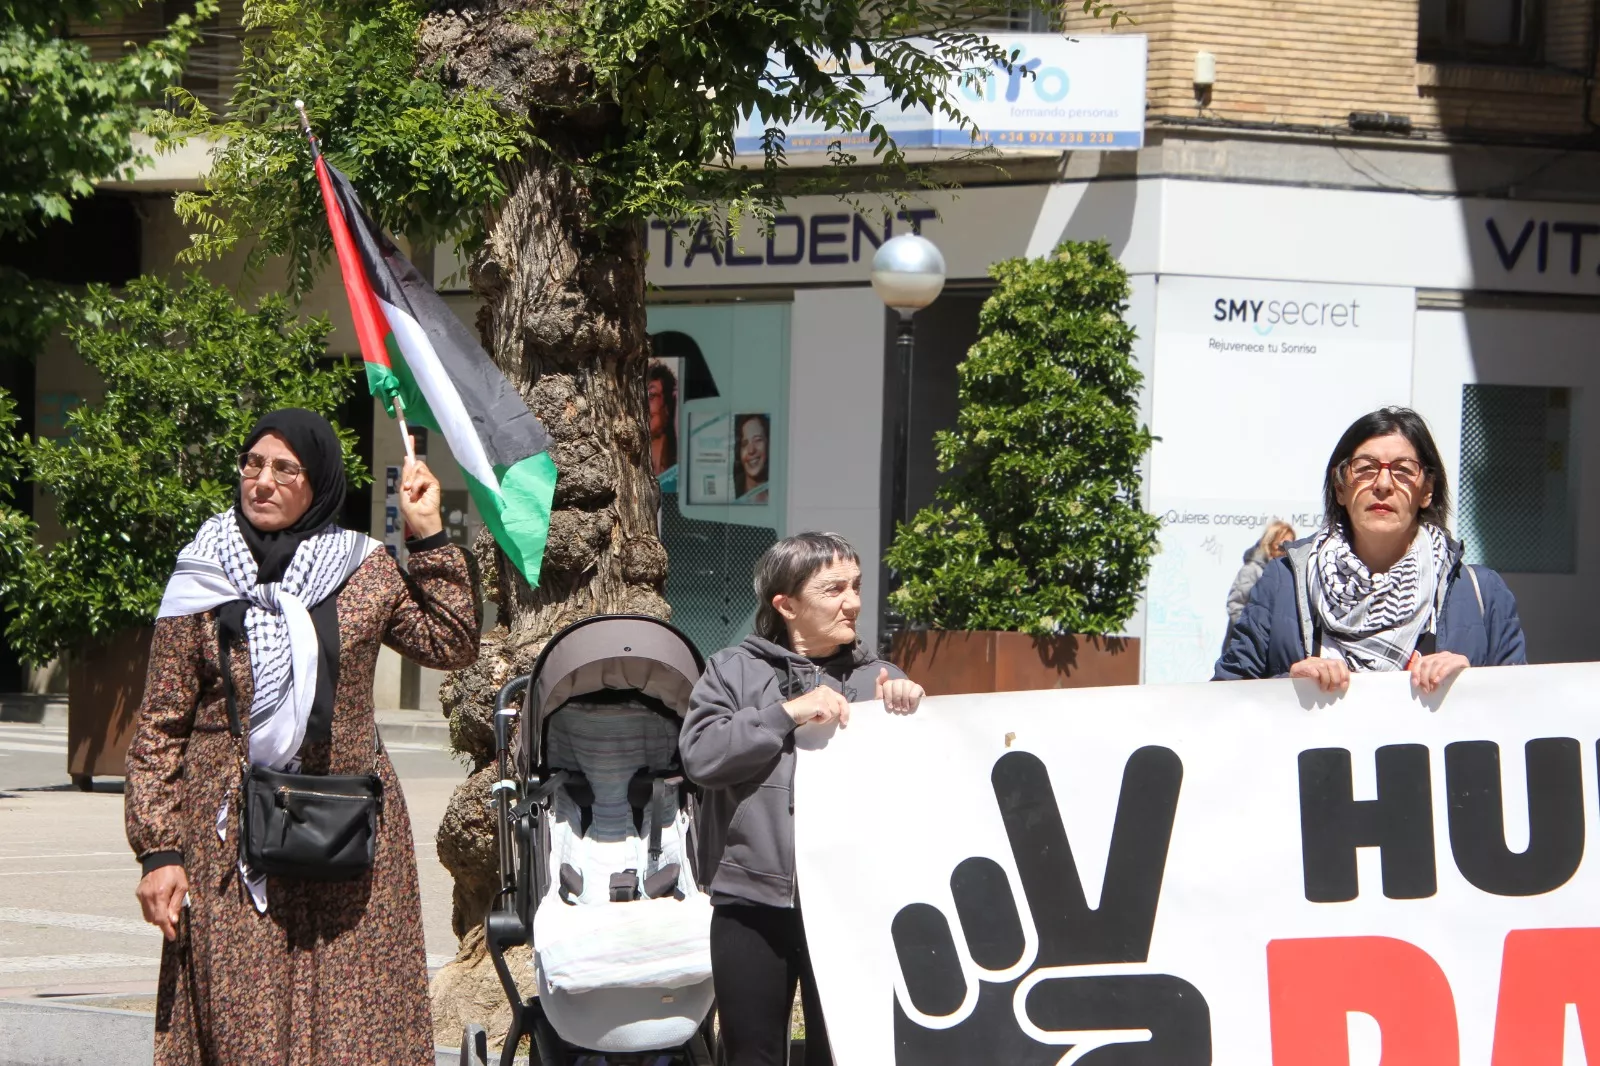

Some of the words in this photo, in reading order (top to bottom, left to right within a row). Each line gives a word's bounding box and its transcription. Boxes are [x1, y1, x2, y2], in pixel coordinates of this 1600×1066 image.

[1010, 107, 1066, 118] formando
[1068, 109, 1119, 119] personas
[1000, 131, 1024, 143] +34
[1029, 131, 1054, 143] 974
[1485, 217, 1600, 275] VIT
[1209, 338, 1265, 353] Rejuvenece
[1268, 343, 1278, 353] tu
[1281, 342, 1317, 354] Sonrisa
[1214, 512, 1268, 529] conseguir
[1297, 736, 1600, 904] HU
